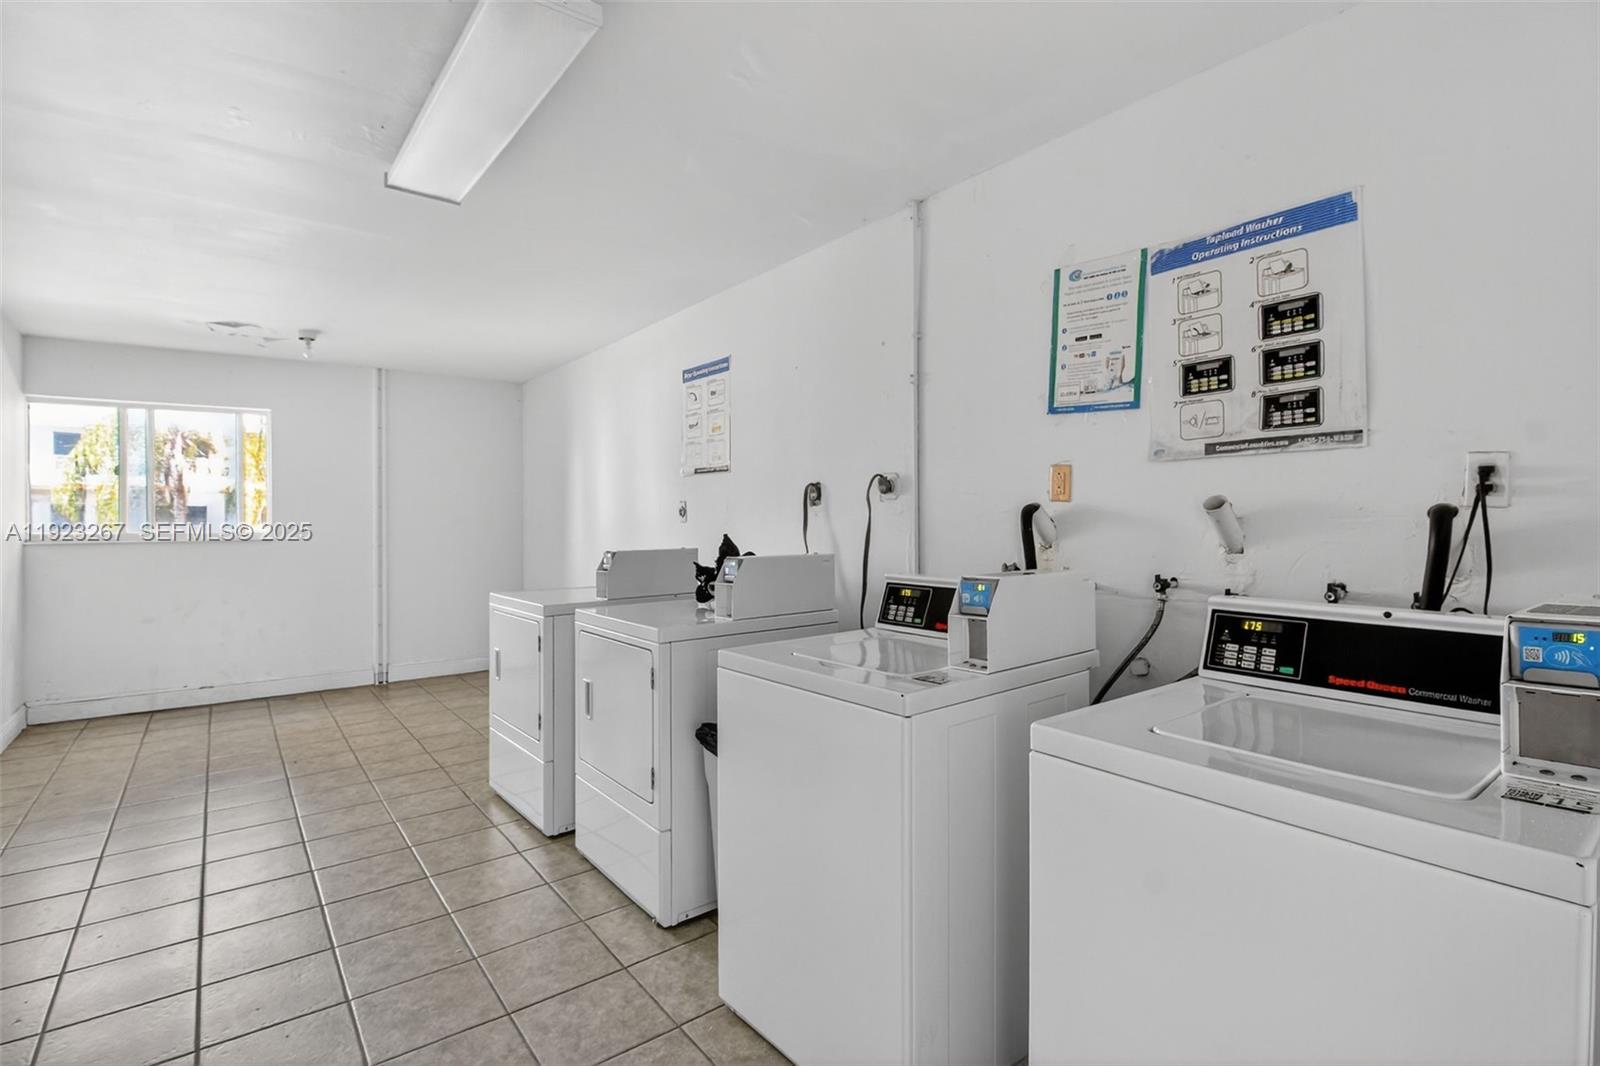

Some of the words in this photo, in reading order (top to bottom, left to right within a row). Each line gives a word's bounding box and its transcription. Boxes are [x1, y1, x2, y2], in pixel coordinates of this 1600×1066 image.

[1245, 216, 1284, 233] Washer
[1191, 242, 1240, 261] Operating
[1240, 225, 1303, 248] Instructions
[1572, 633, 1585, 644] 15
[1327, 674, 1365, 688] Speed
[1366, 680, 1407, 694] Queen
[1408, 687, 1458, 702] Commercial
[1459, 694, 1492, 707] Washer
